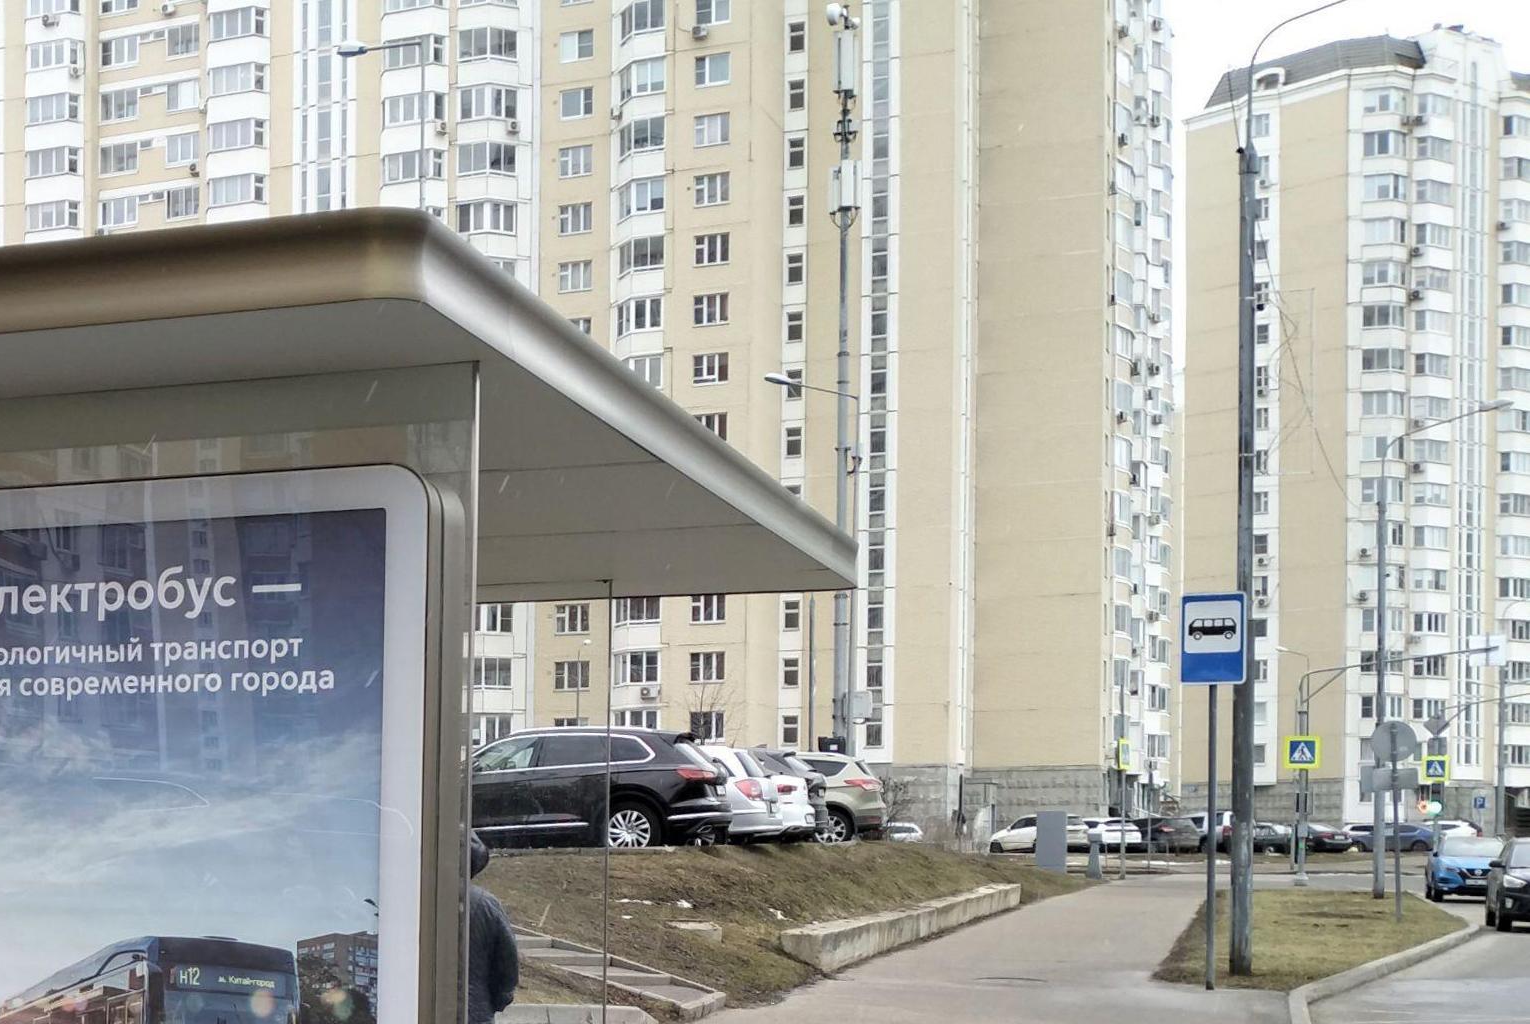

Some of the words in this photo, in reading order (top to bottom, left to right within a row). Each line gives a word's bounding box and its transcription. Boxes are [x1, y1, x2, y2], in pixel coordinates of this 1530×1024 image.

[150, 636, 303, 667] транспорт
[19, 671, 223, 701] современного
[231, 669, 335, 697] города
